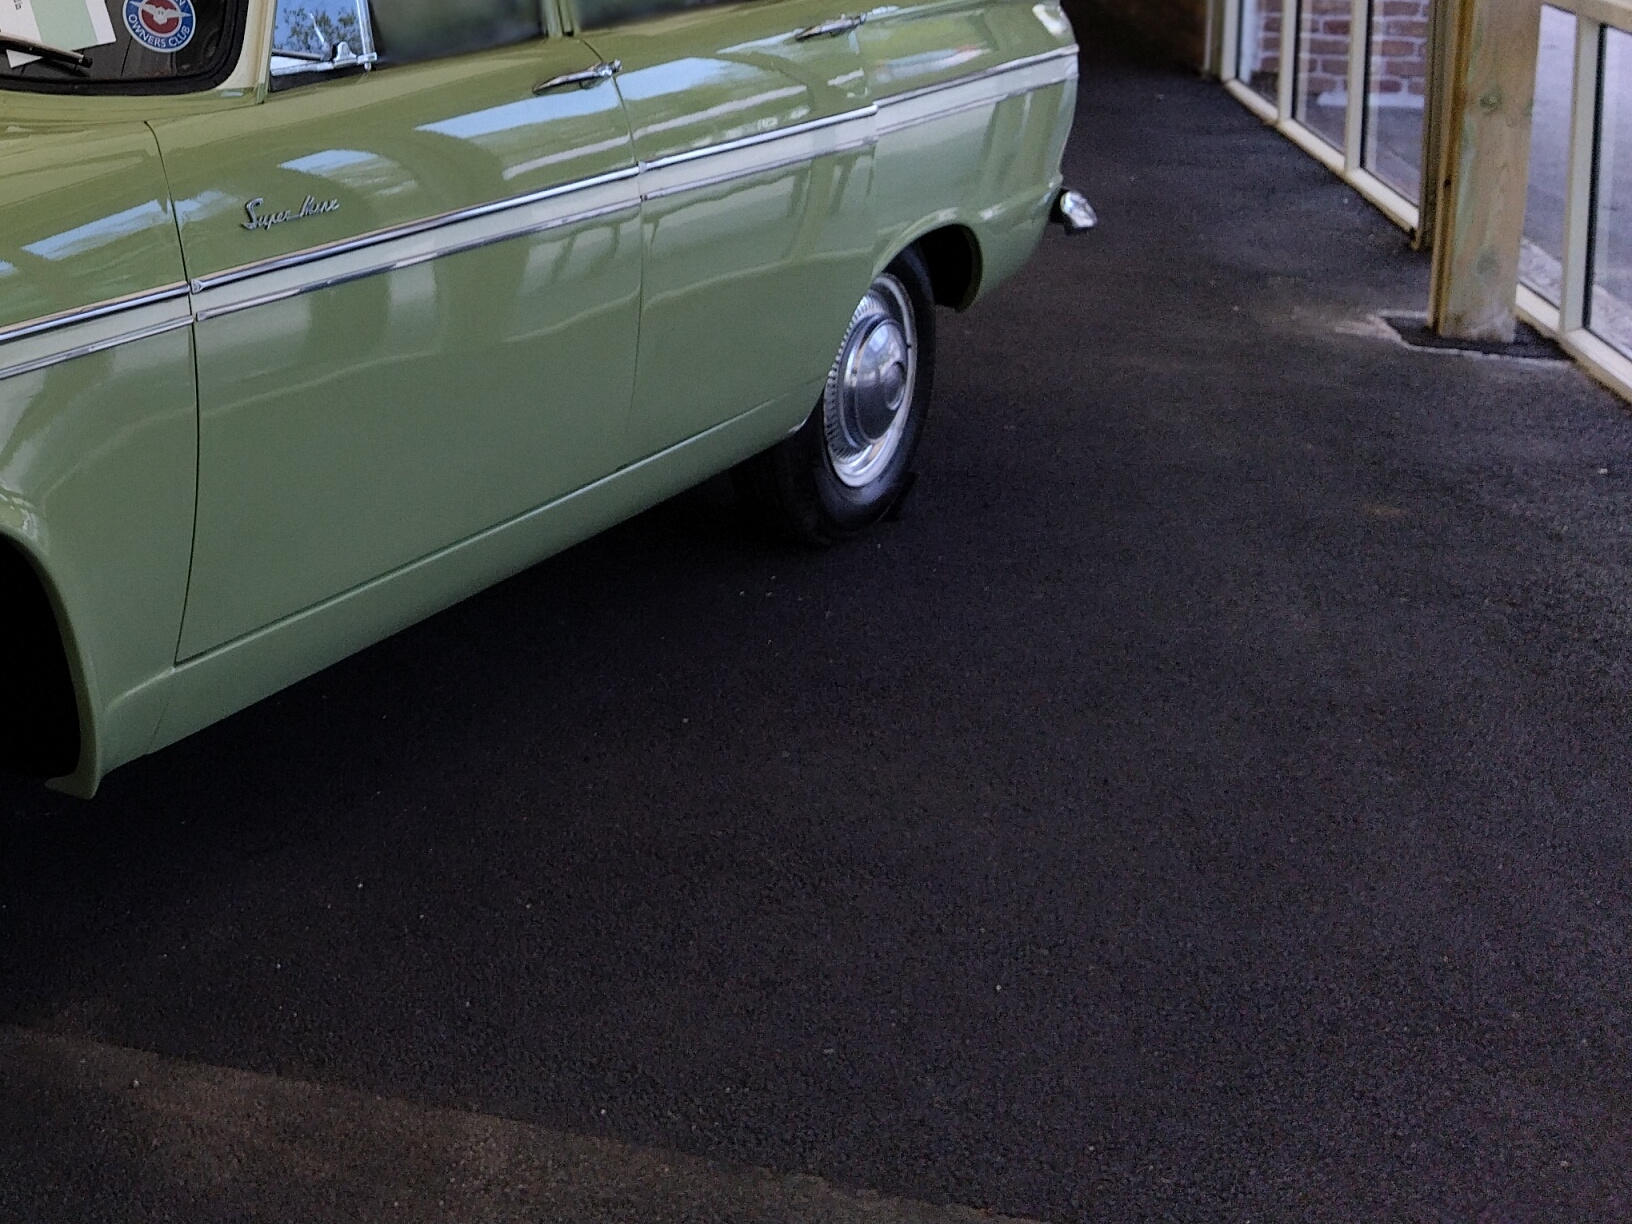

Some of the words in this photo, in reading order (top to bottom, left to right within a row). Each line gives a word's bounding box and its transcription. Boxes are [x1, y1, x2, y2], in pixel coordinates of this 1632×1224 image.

[128, 14, 167, 48] OWNERS
[168, 25, 191, 47] CLUB
[242, 196, 293, 230] Super
